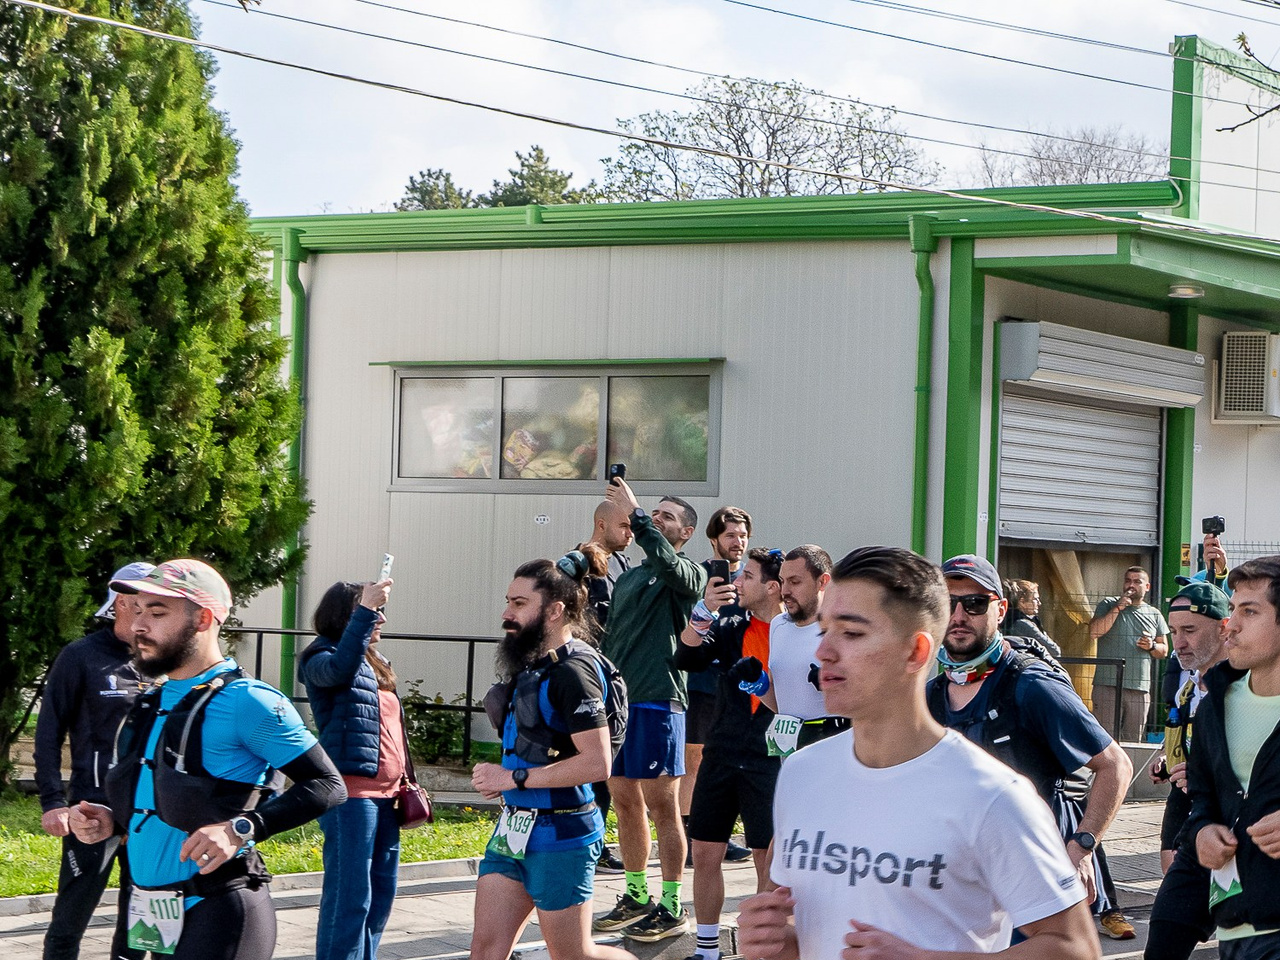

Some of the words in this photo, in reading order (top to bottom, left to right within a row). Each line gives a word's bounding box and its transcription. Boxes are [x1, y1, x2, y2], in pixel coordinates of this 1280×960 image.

[774, 718, 799, 735] 4115
[506, 814, 532, 834] 4139
[149, 897, 180, 920] 4110
